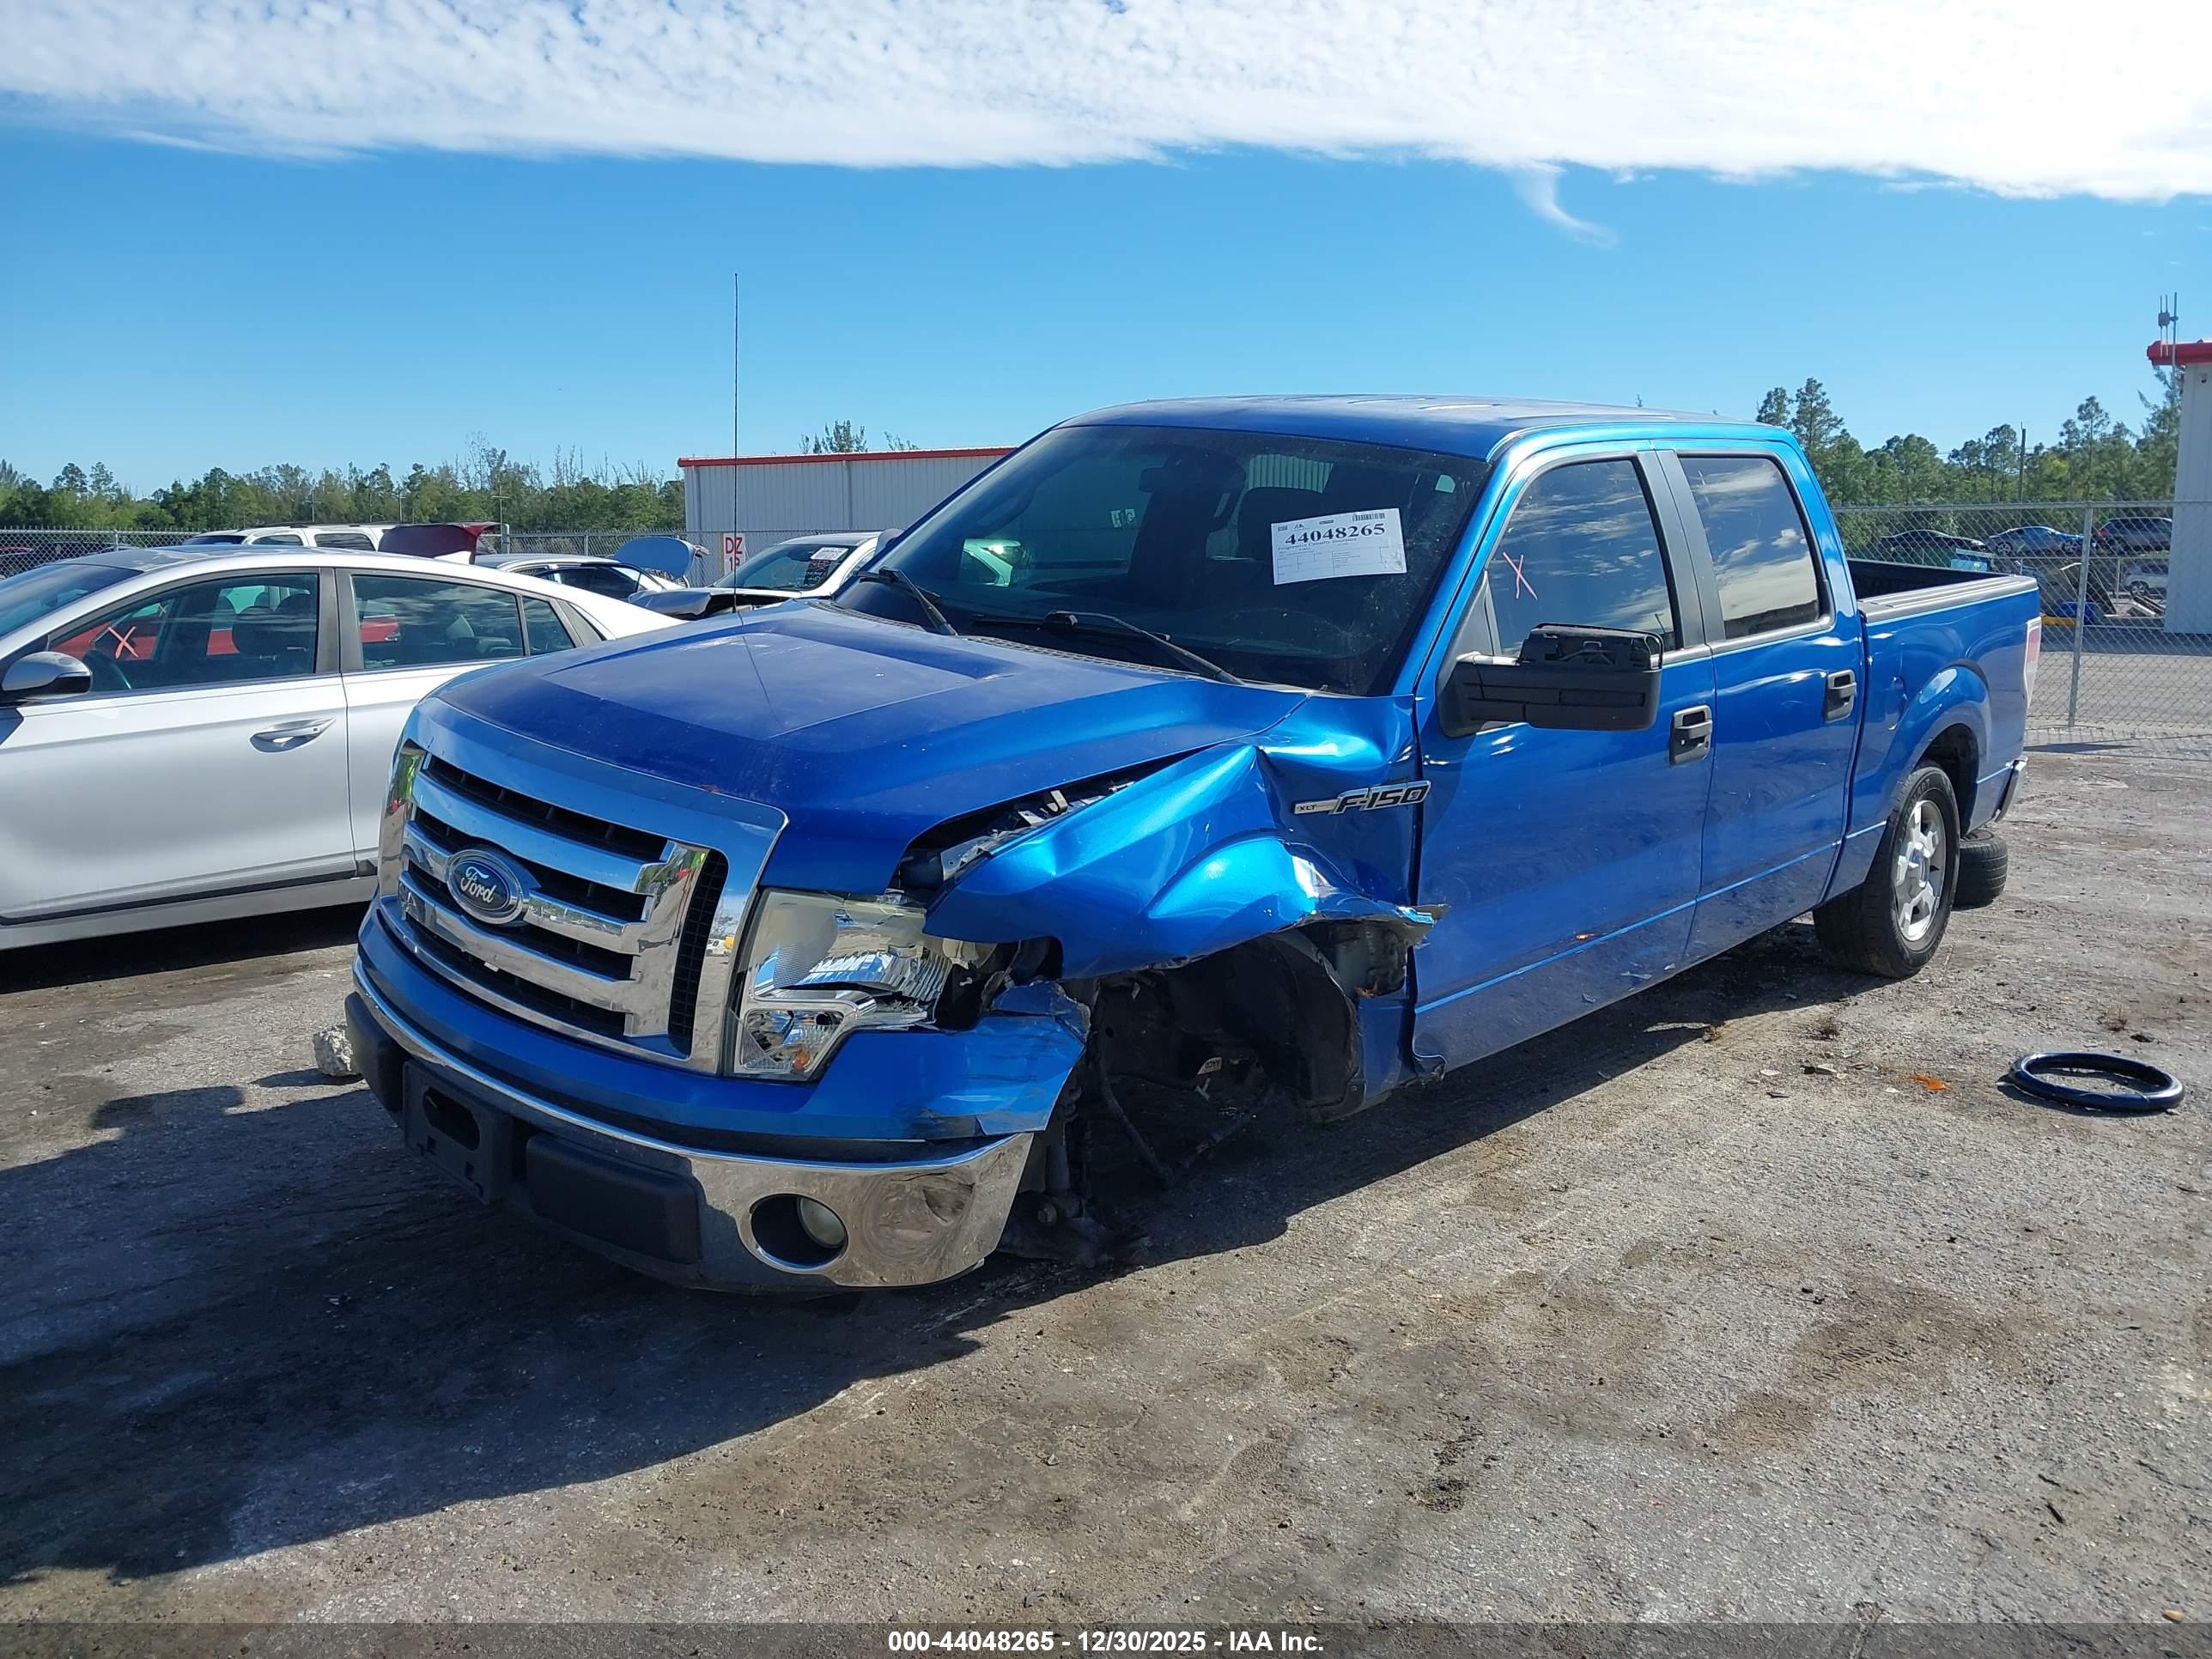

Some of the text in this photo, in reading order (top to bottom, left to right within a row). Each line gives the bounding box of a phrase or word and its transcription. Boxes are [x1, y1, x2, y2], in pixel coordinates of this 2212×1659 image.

[725, 537, 743, 554] DZ
[1285, 523, 1385, 545] 44048265
[1333, 781, 1431, 814] F-150
[460, 866, 497, 903] Ford
